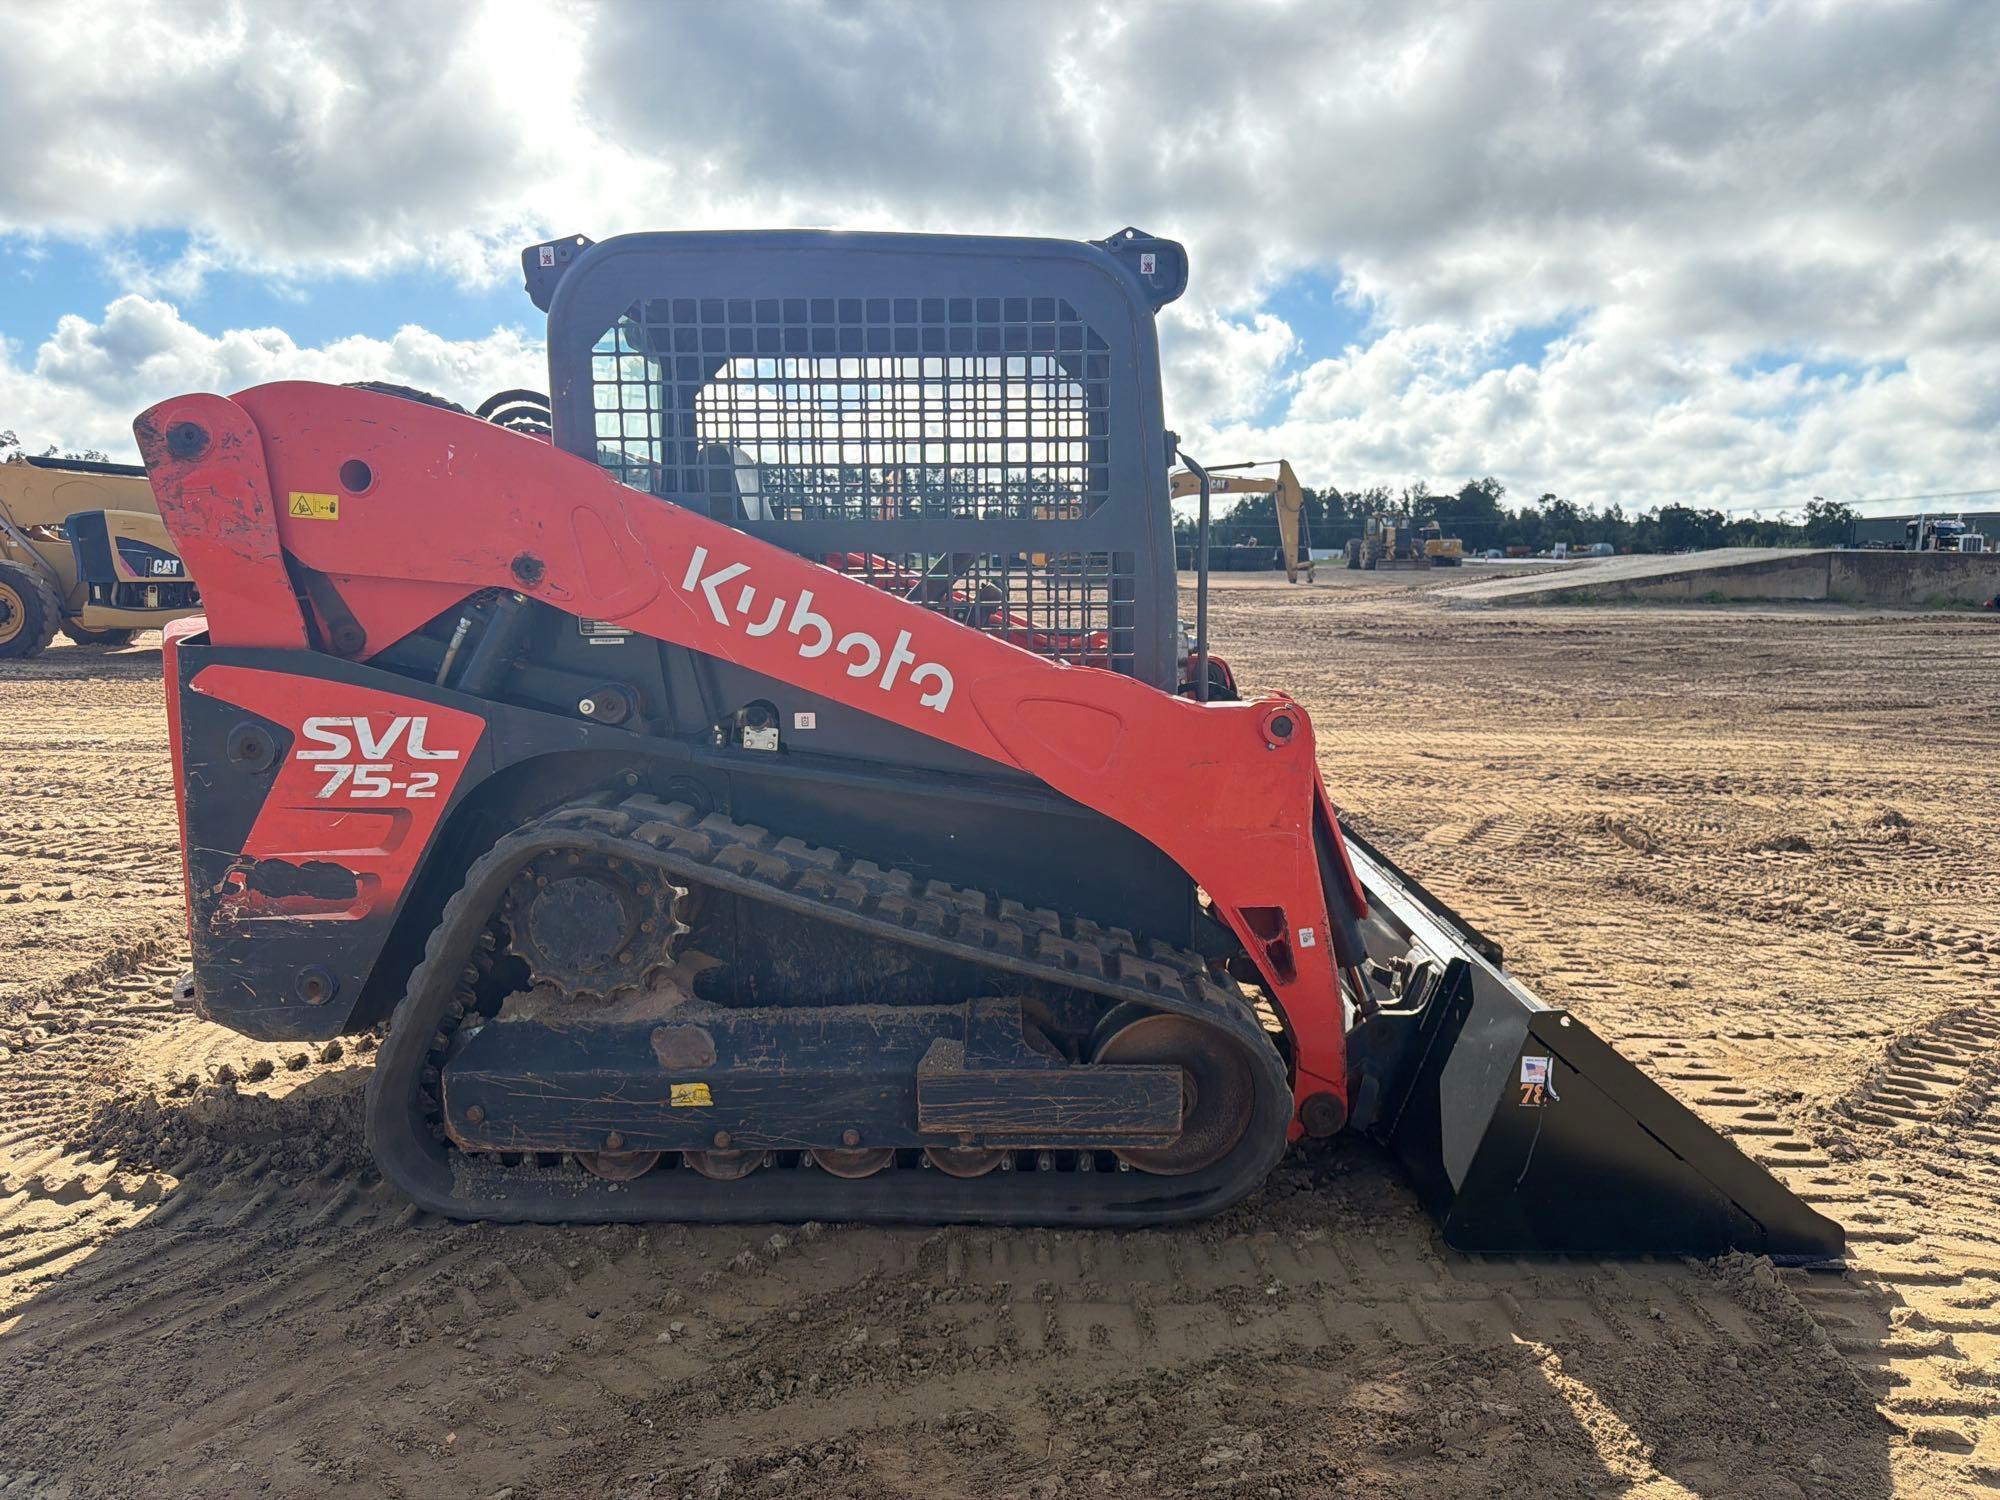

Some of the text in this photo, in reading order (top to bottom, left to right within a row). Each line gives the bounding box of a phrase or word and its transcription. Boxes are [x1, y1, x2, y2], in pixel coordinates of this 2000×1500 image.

[1210, 479, 1226, 489] CAT
[153, 559, 180, 575] CAT
[681, 545, 954, 713] Kubota
[296, 716, 460, 760] SVL
[313, 764, 439, 798] 75-2
